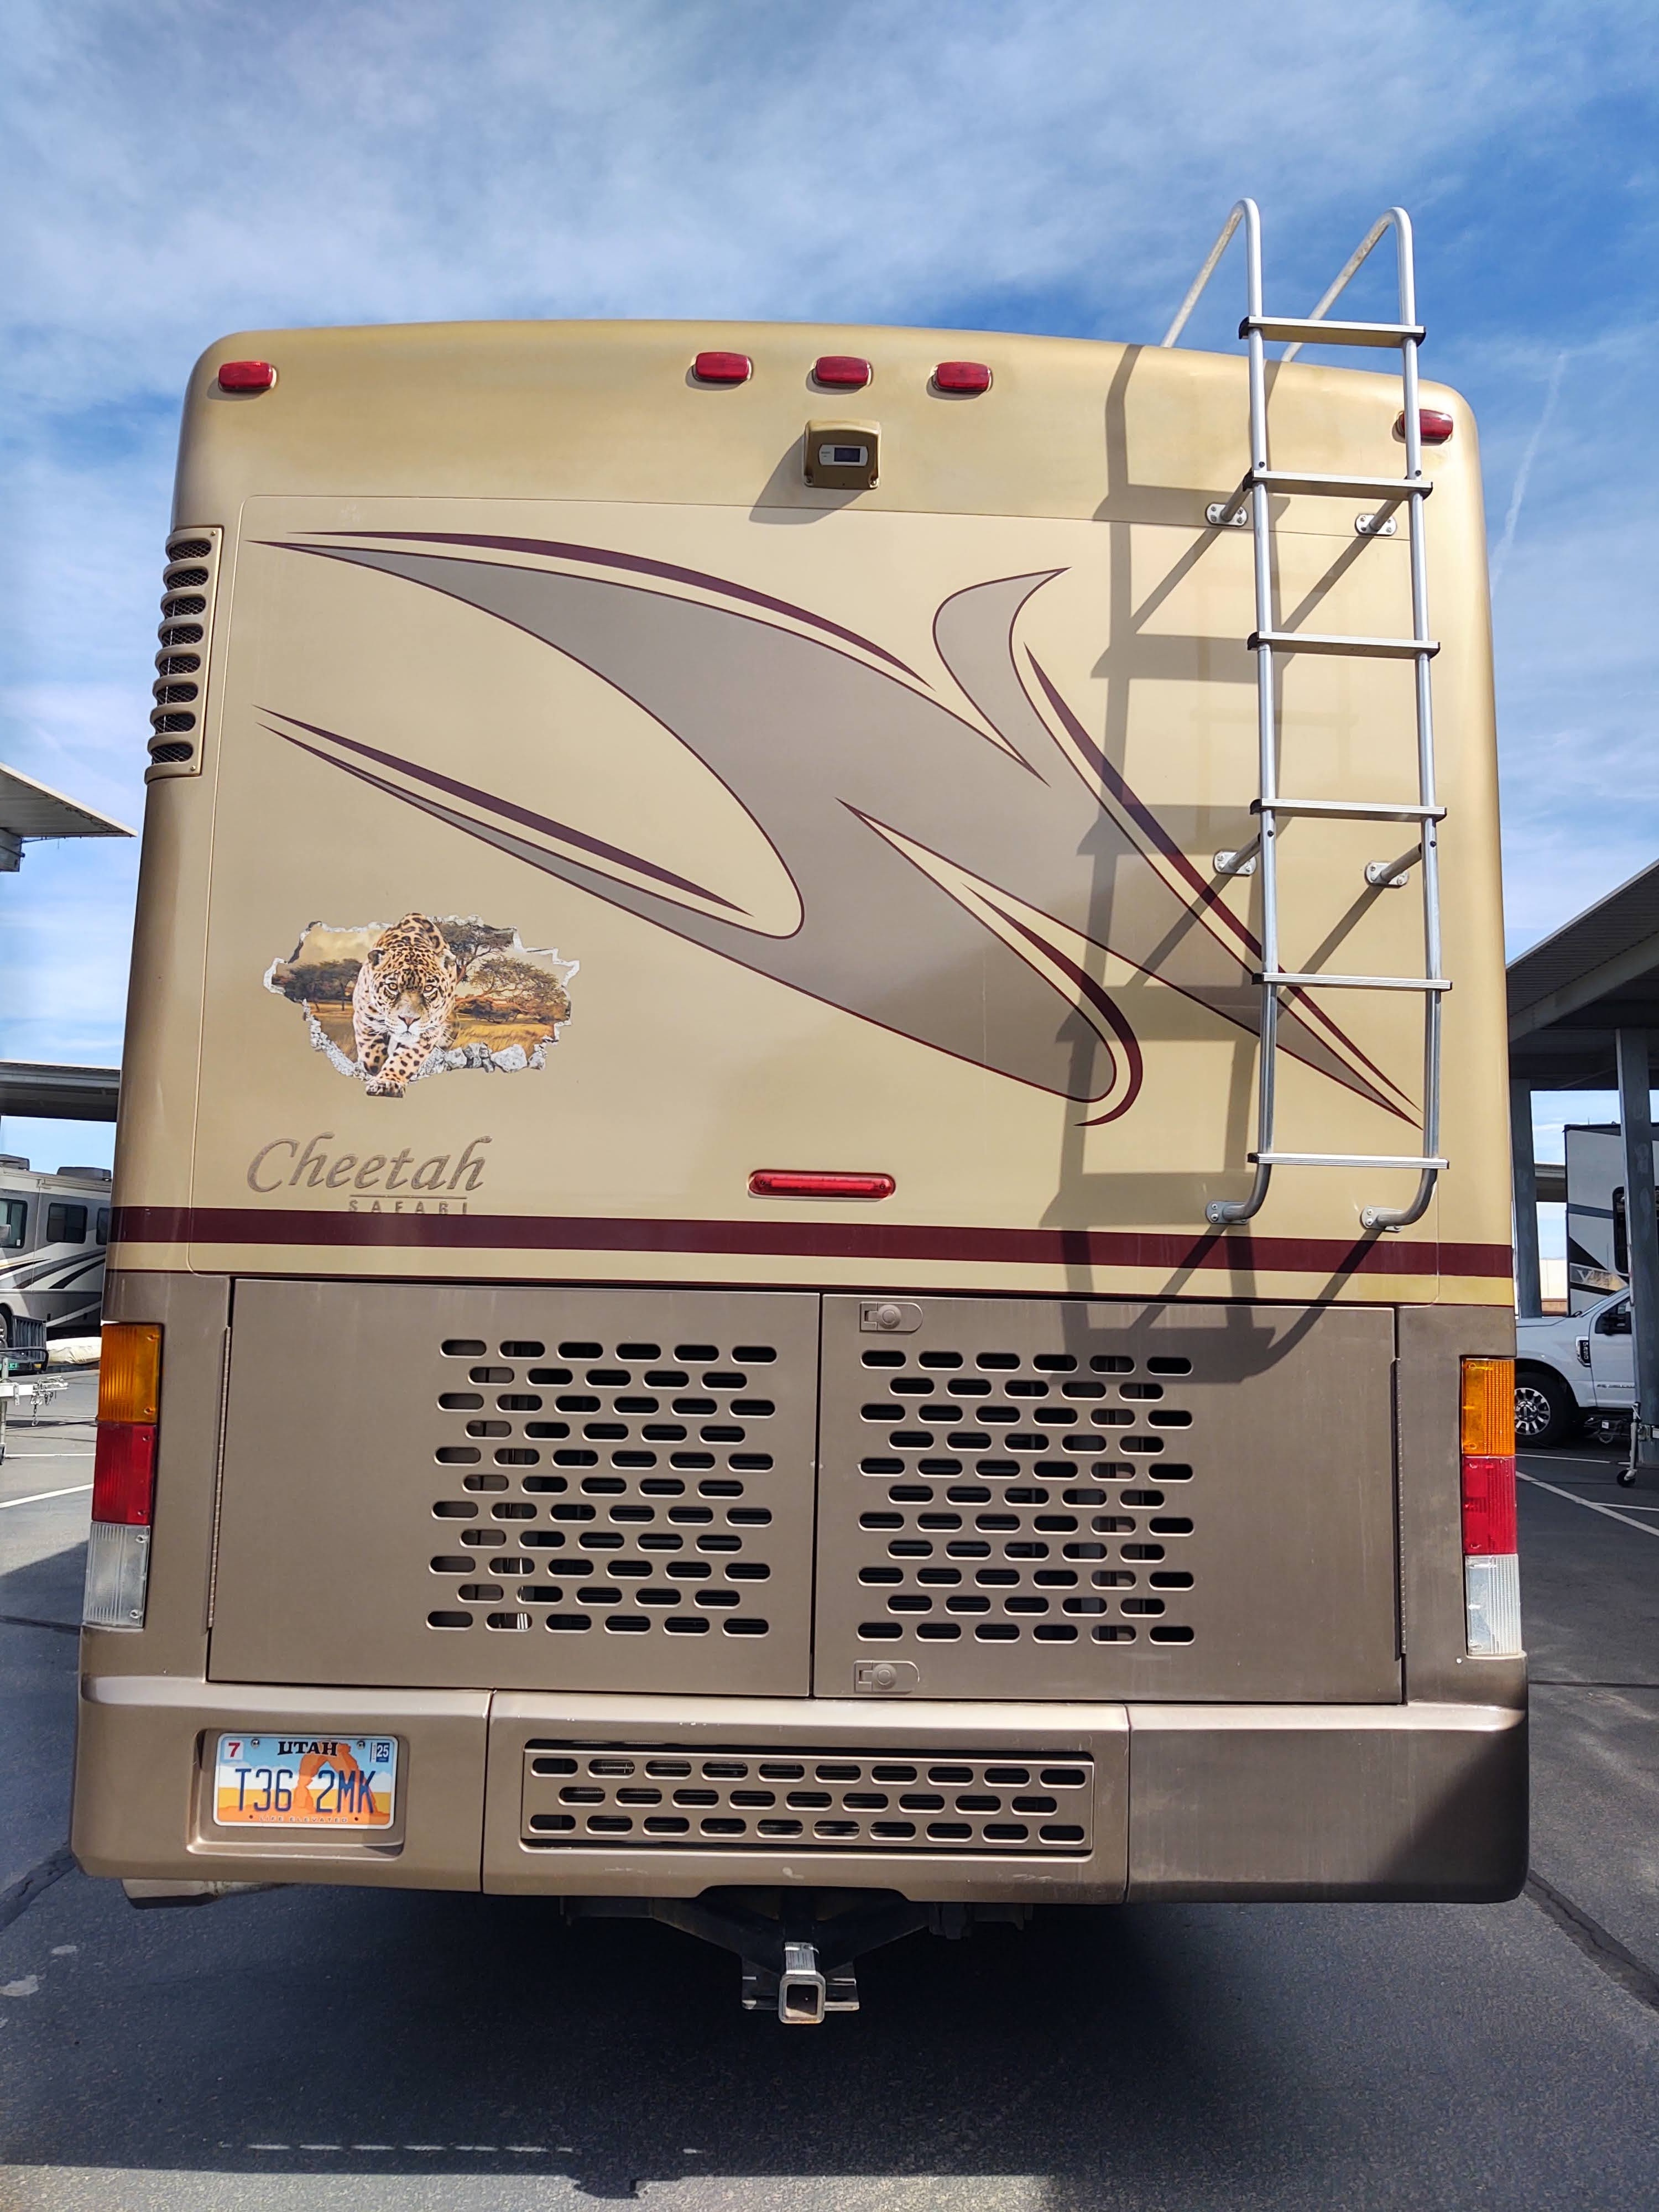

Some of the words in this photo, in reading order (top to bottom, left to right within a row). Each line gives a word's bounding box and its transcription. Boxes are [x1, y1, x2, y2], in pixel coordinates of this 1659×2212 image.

[247, 1131, 493, 1192] Cheetah
[349, 1199, 467, 1215] SAFARI
[228, 1743, 241, 1757] 7
[278, 1741, 337, 1756] UTAH
[377, 1744, 389, 1757] 25
